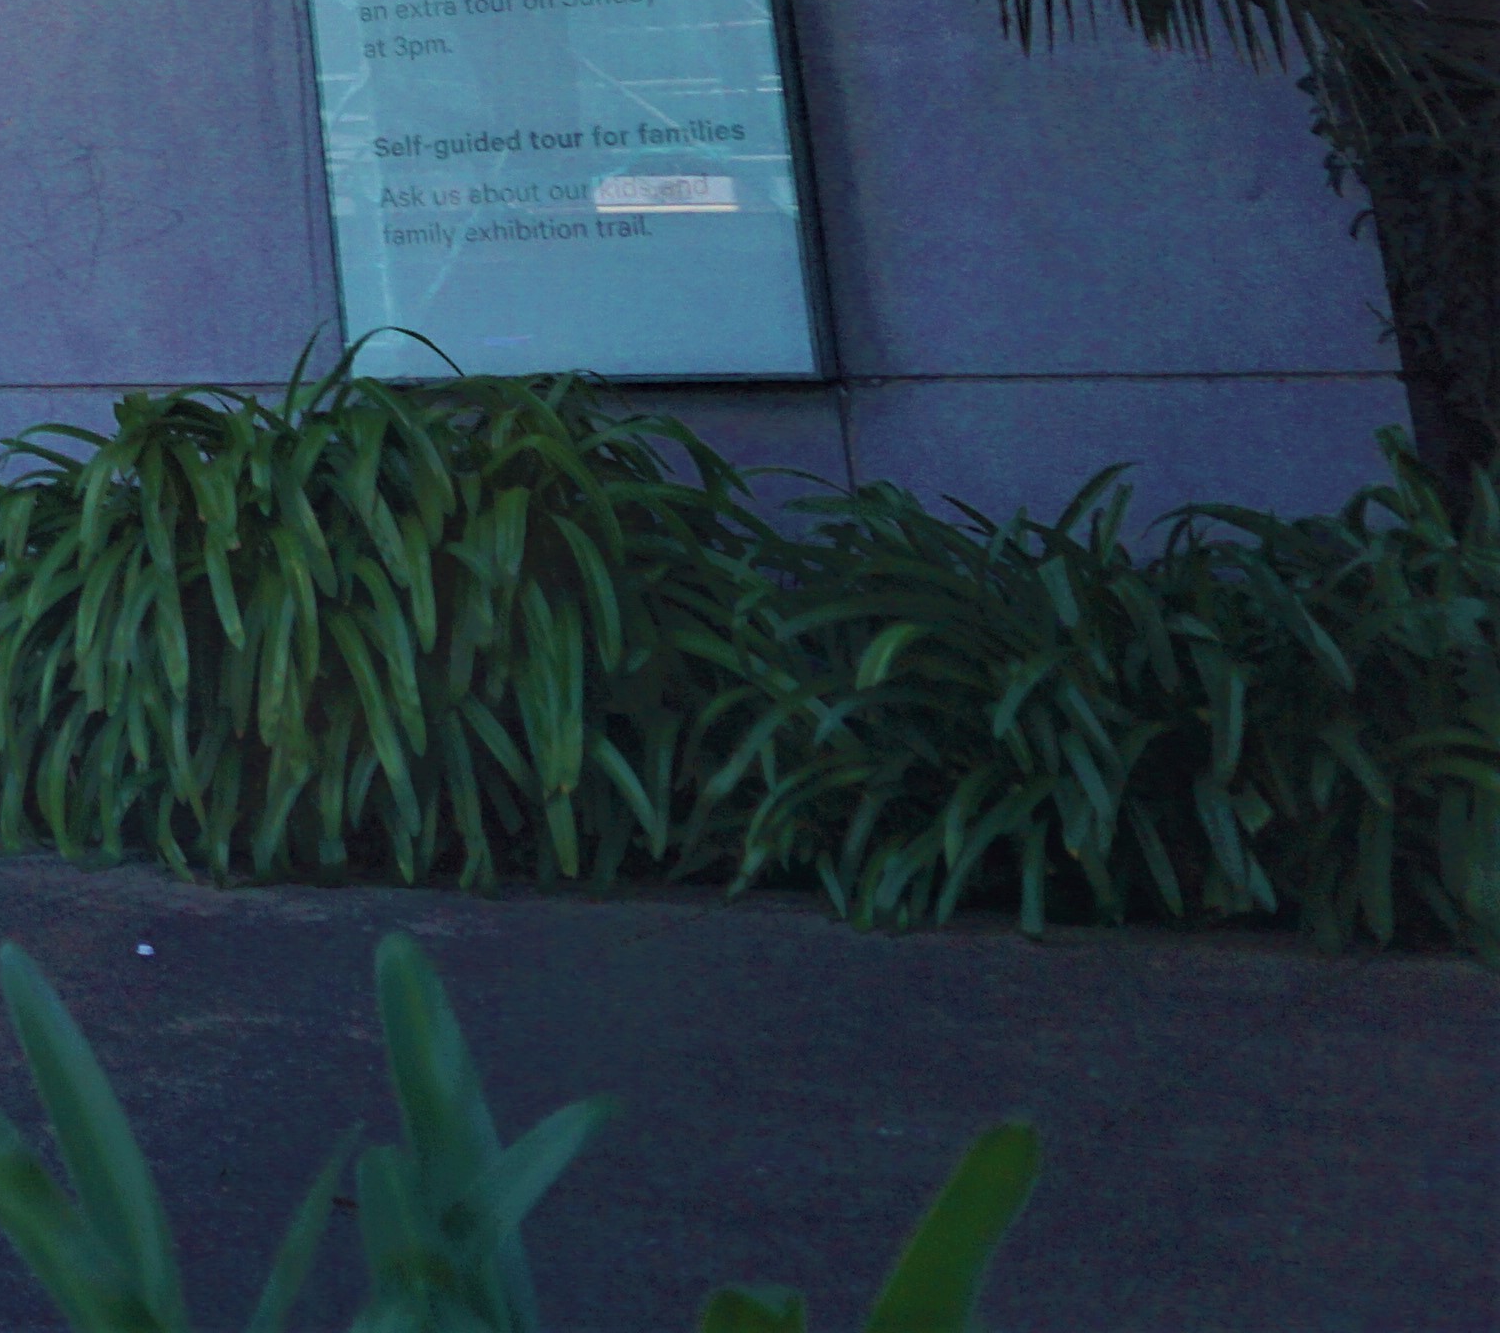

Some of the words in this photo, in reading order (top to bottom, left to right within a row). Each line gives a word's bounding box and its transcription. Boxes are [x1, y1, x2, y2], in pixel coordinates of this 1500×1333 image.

[359, 4, 388, 23] an
[395, 0, 457, 20] extra
[363, 38, 387, 59] at
[394, 36, 453, 61] 3pm.
[372, 129, 522, 160] Self-guided
[528, 130, 583, 151] tour
[592, 124, 631, 148] for
[637, 119, 747, 146] families
[379, 184, 426, 208] Ask
[432, 189, 462, 207] us
[468, 182, 541, 205] about
[549, 183, 589, 201] our
[382, 220, 455, 249] family
[465, 218, 589, 243] exhibition
